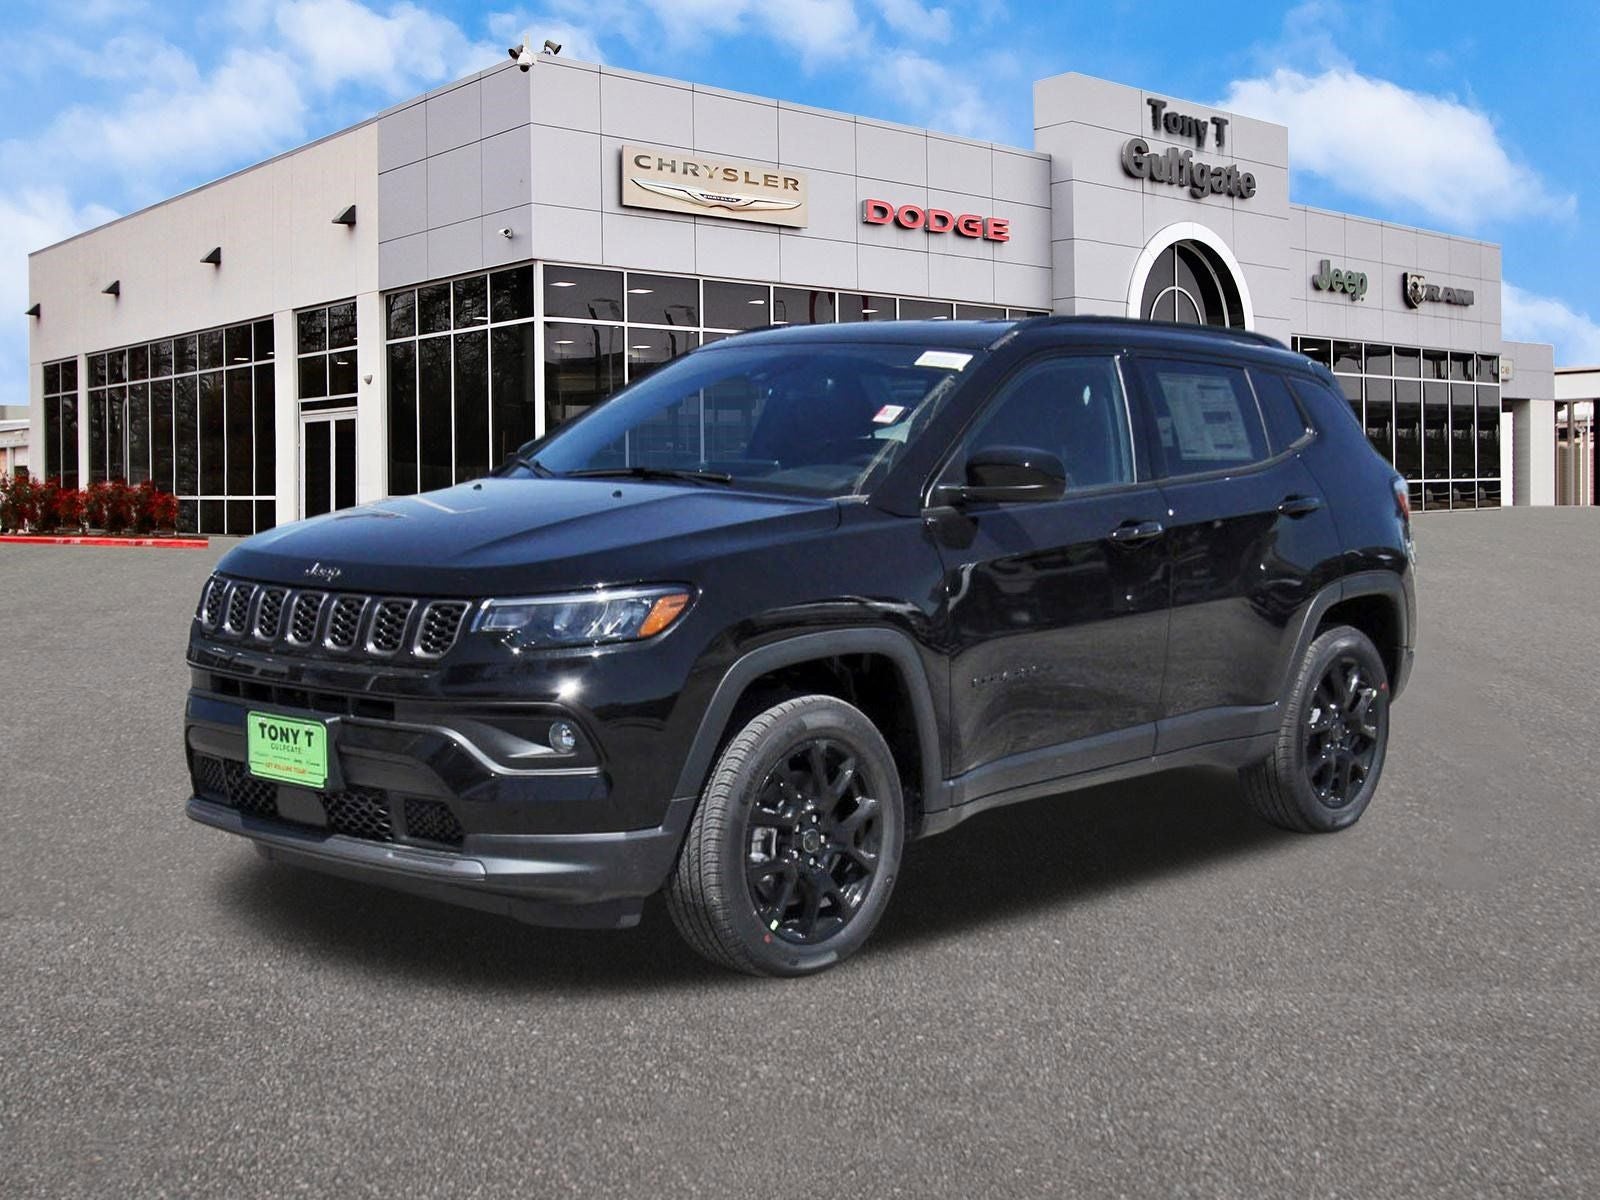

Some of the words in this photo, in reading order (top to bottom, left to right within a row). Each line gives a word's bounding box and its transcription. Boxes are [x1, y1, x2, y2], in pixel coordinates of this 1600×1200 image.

[1146, 98, 1208, 148] Tony
[1210, 116, 1229, 148] T
[633, 153, 800, 192] CHRYSLER
[1121, 137, 1257, 199] Gulfgate
[862, 198, 1010, 243] DODGE
[1313, 260, 1368, 301] Jeep
[1425, 284, 1475, 306] RAM
[258, 722, 300, 745] TONY
[304, 730, 314, 747] T
